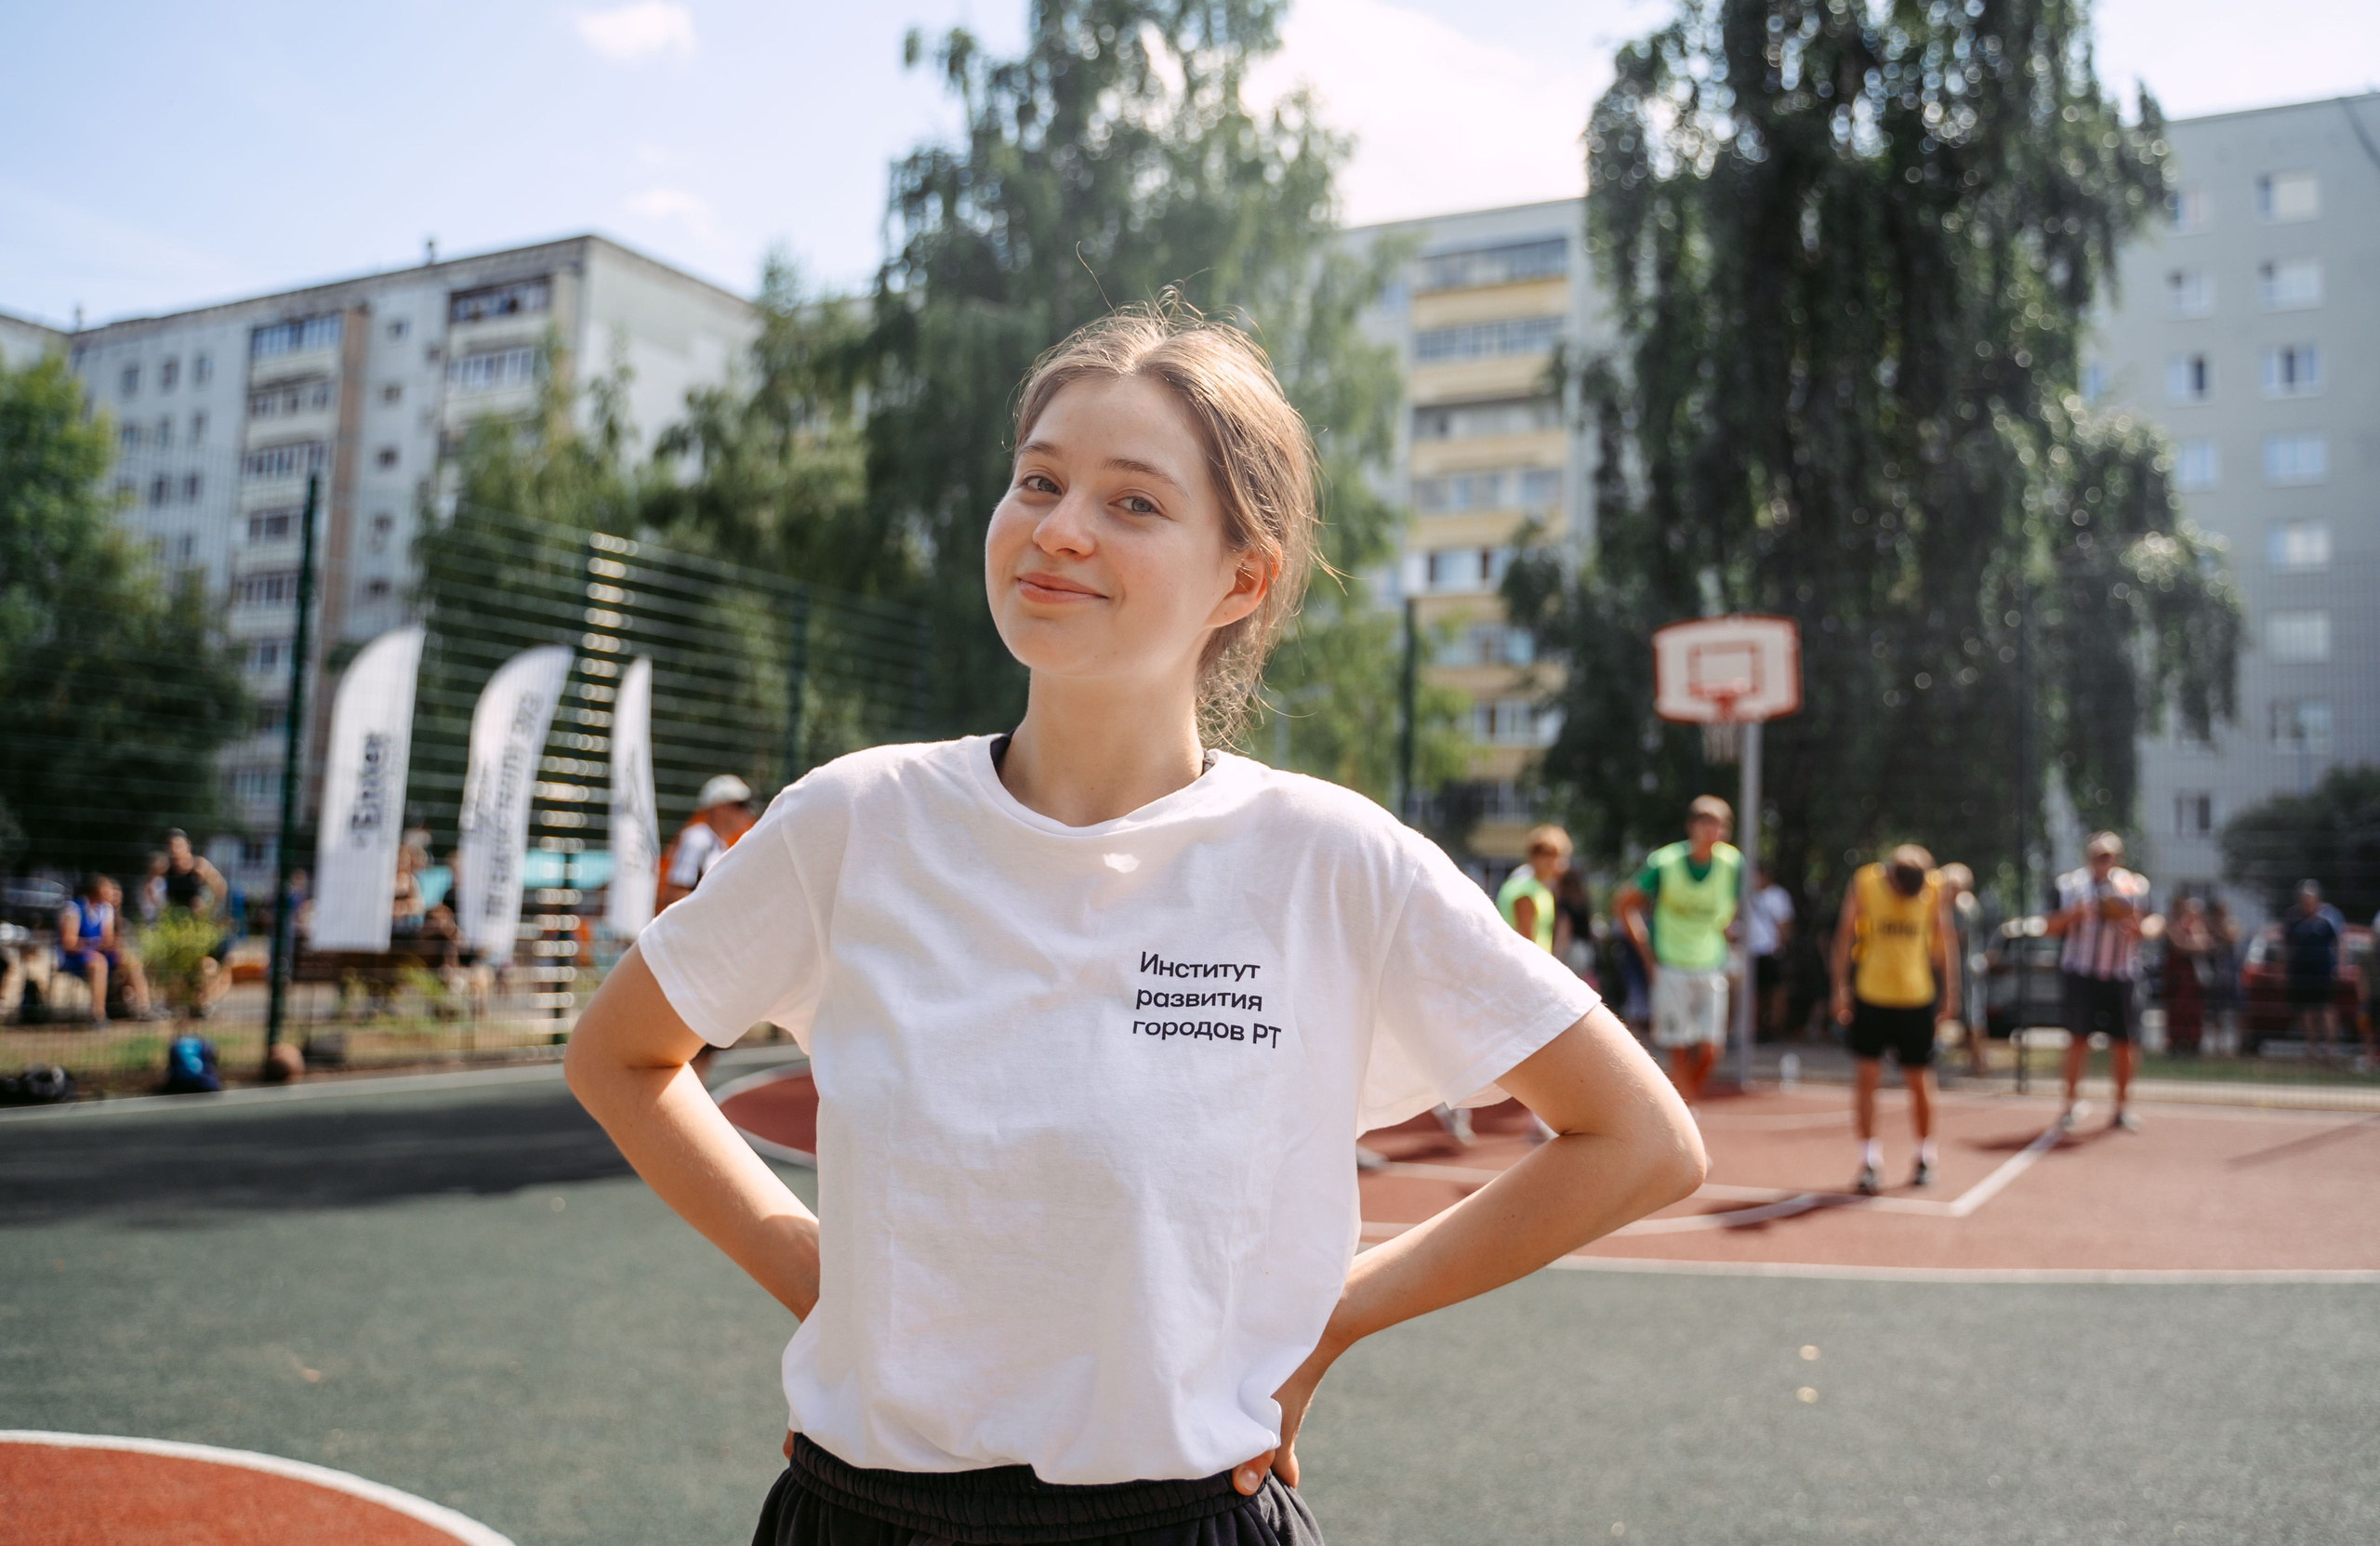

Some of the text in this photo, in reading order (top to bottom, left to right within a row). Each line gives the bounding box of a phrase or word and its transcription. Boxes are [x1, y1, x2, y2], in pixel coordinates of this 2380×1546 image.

[1140, 951, 1262, 983] Институт
[1135, 988, 1263, 1012] развития
[1132, 1020, 1282, 1050] городов РТ
